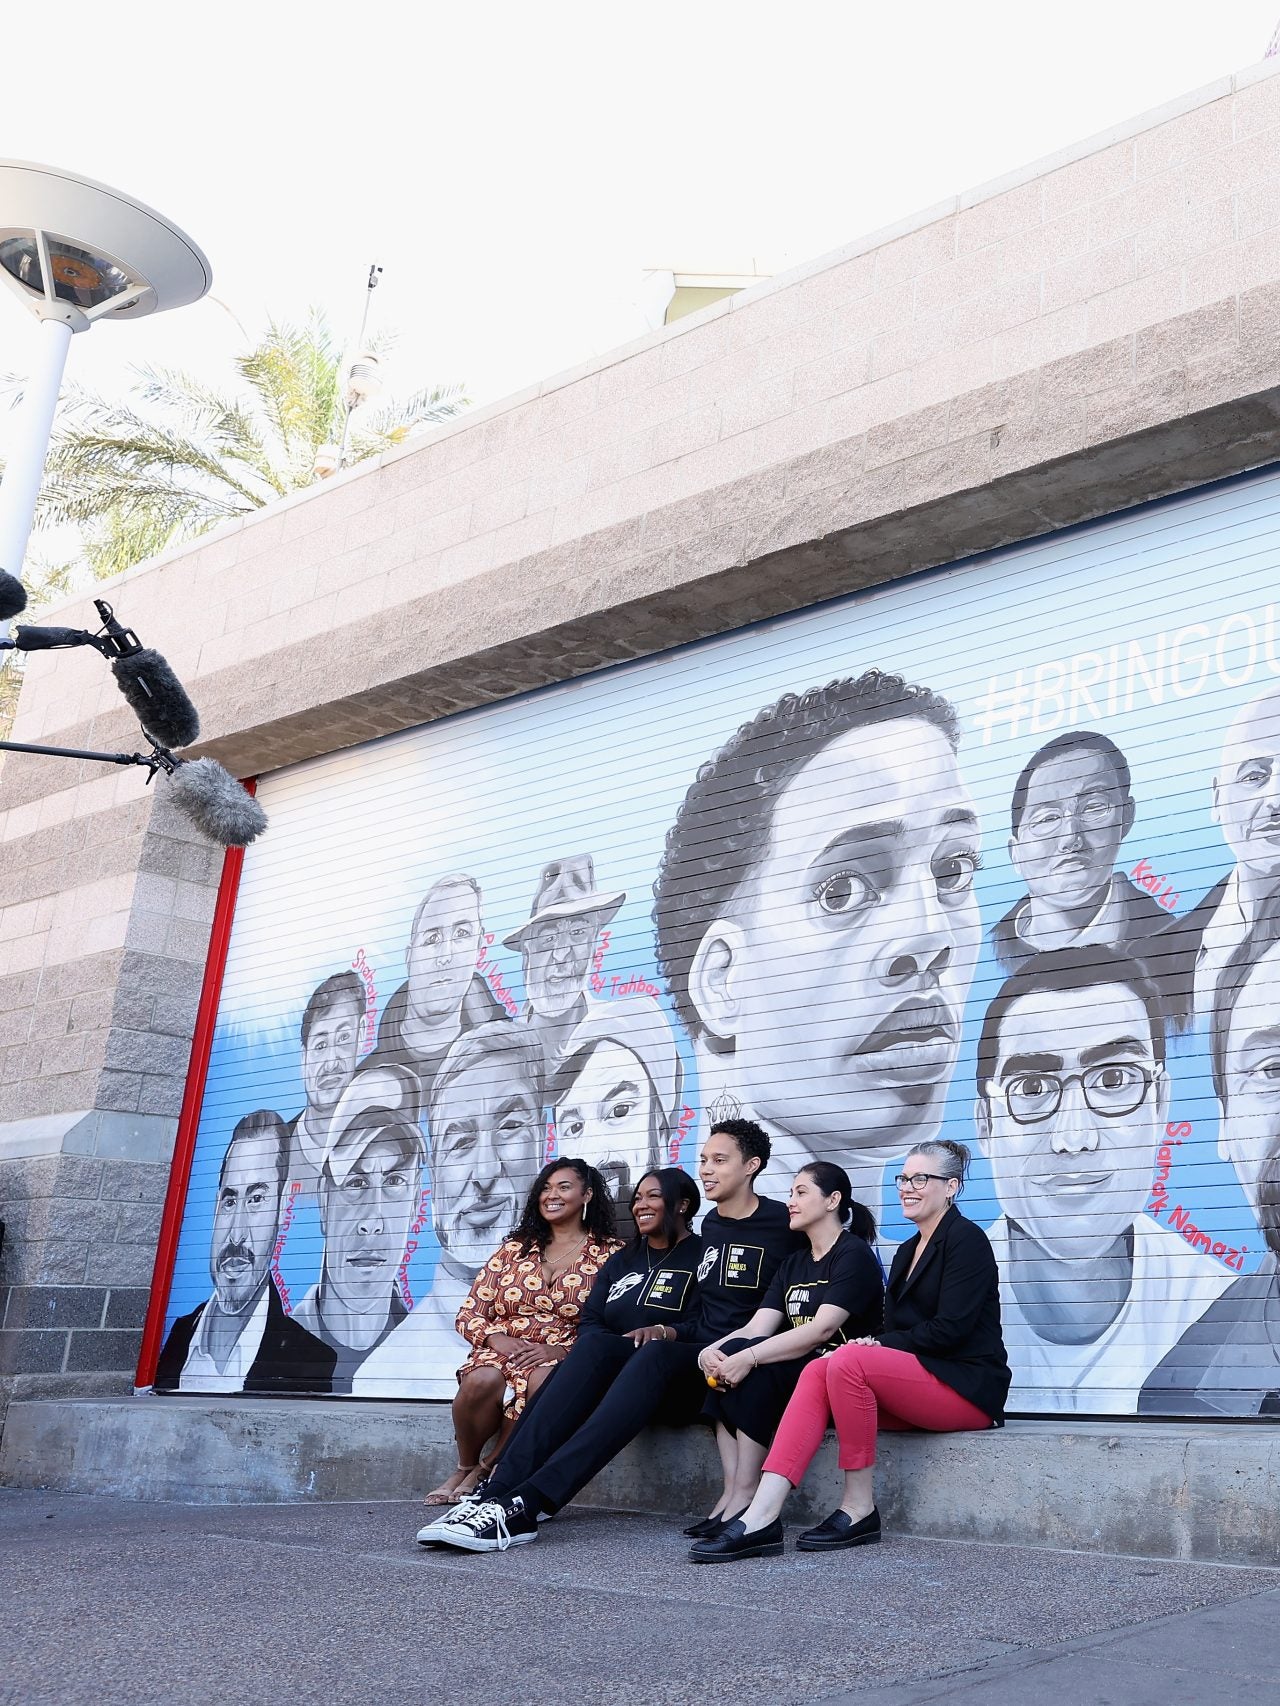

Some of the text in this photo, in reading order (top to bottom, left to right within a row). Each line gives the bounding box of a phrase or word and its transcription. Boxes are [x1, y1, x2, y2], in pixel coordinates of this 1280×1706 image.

[1130, 857, 1180, 909] Kai Li
[476, 934, 495, 973] Paul
[590, 931, 662, 1000] Morad Tahbaz
[1147, 1121, 1249, 1271] Siamak Namazi
[271, 1234, 293, 1317] Hernandez
[399, 1189, 432, 1312] Luke Denman
